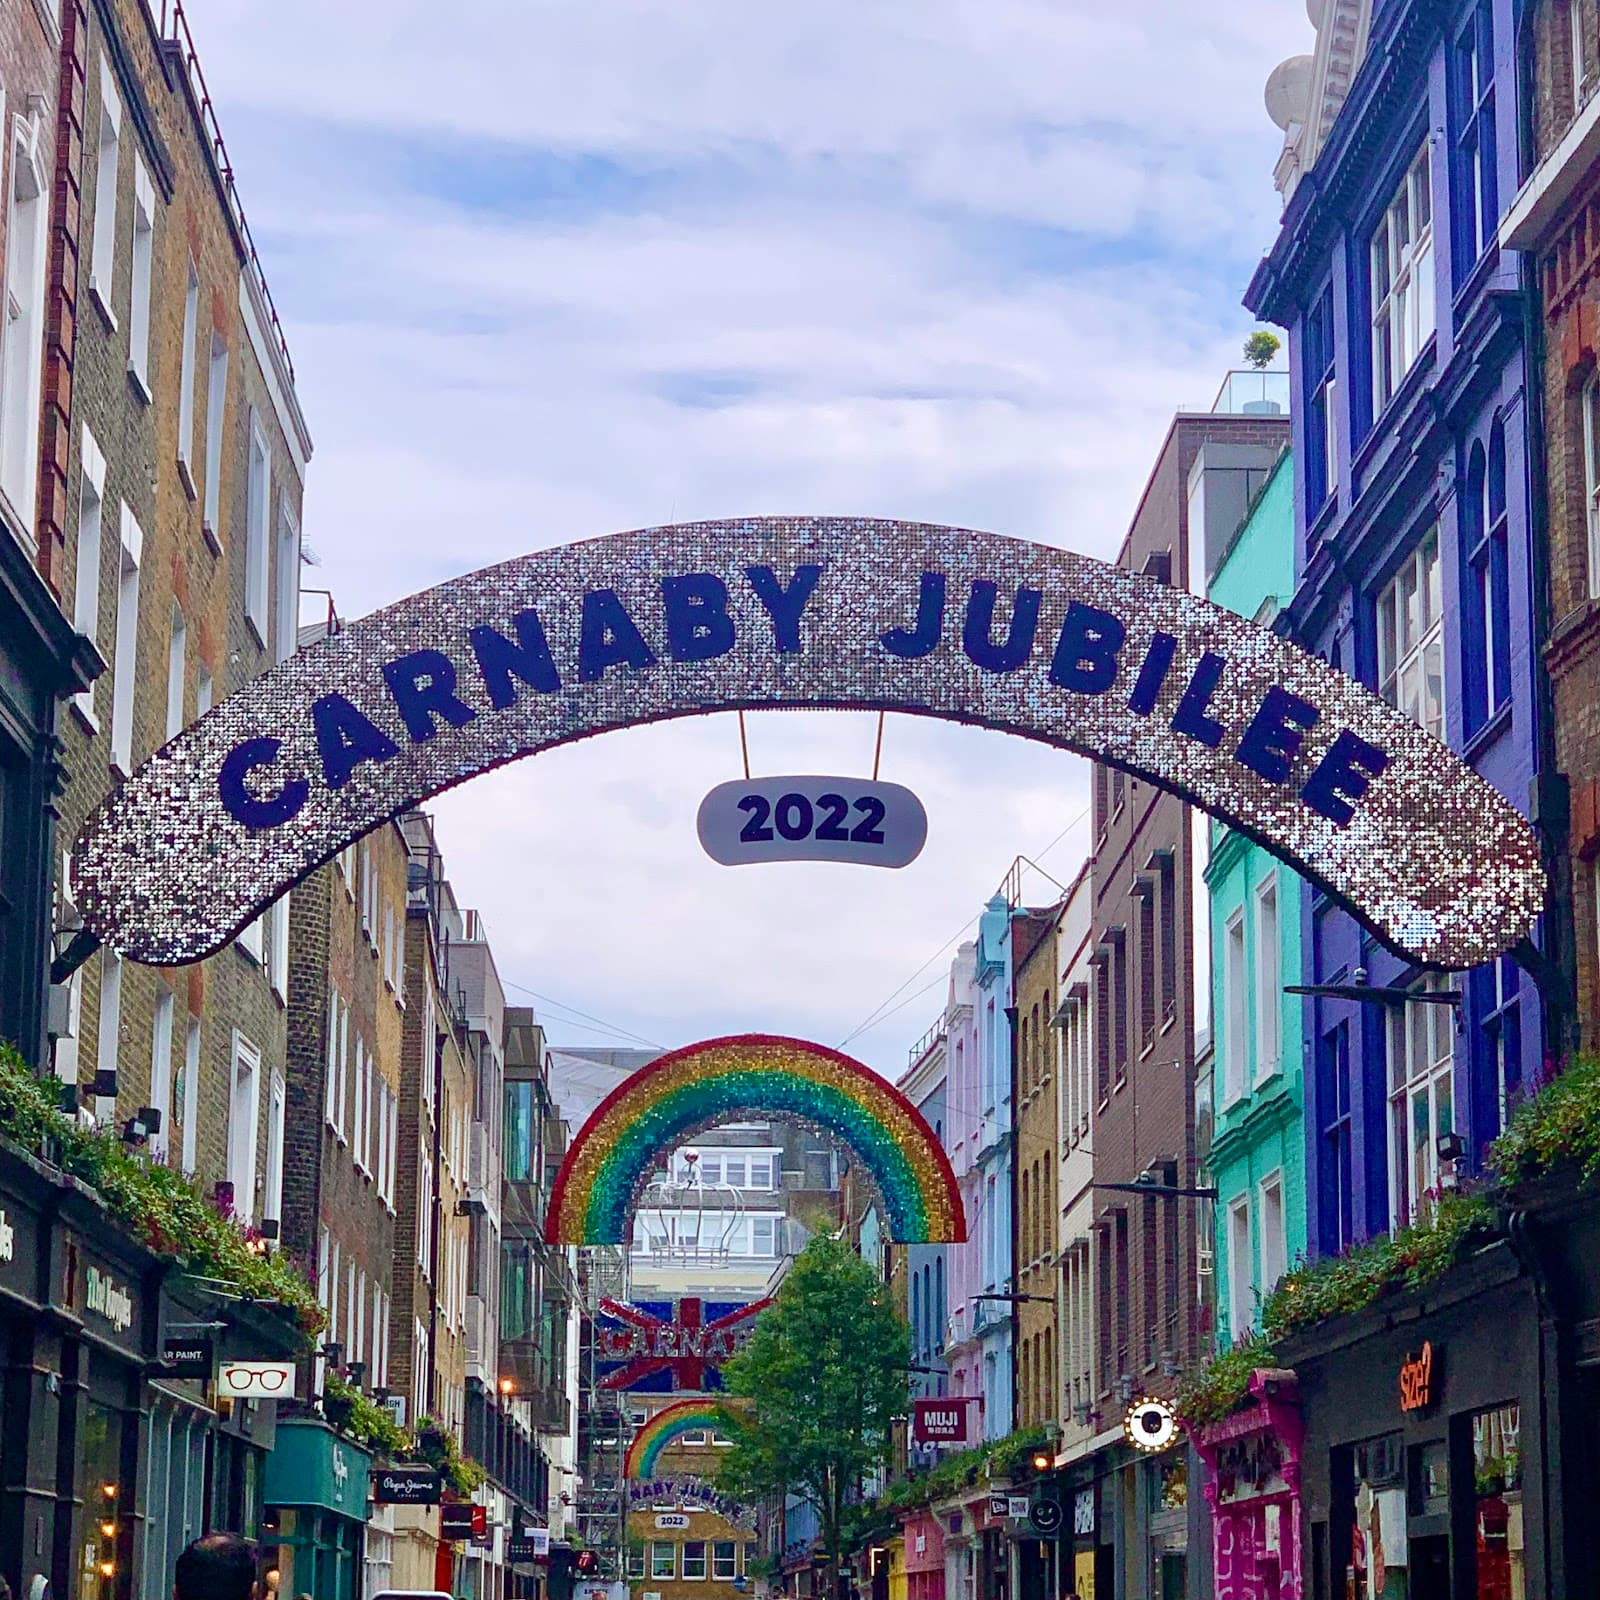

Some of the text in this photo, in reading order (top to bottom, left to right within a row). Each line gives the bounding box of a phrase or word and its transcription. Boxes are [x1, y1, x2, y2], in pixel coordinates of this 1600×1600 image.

[218, 564, 1390, 830] CARNABY JUBILEE
[737, 793, 886, 844] 2022
[1400, 1341, 1432, 1413] size?
[924, 1411, 959, 1427] MUJI
[661, 1516, 684, 1526] 2022
